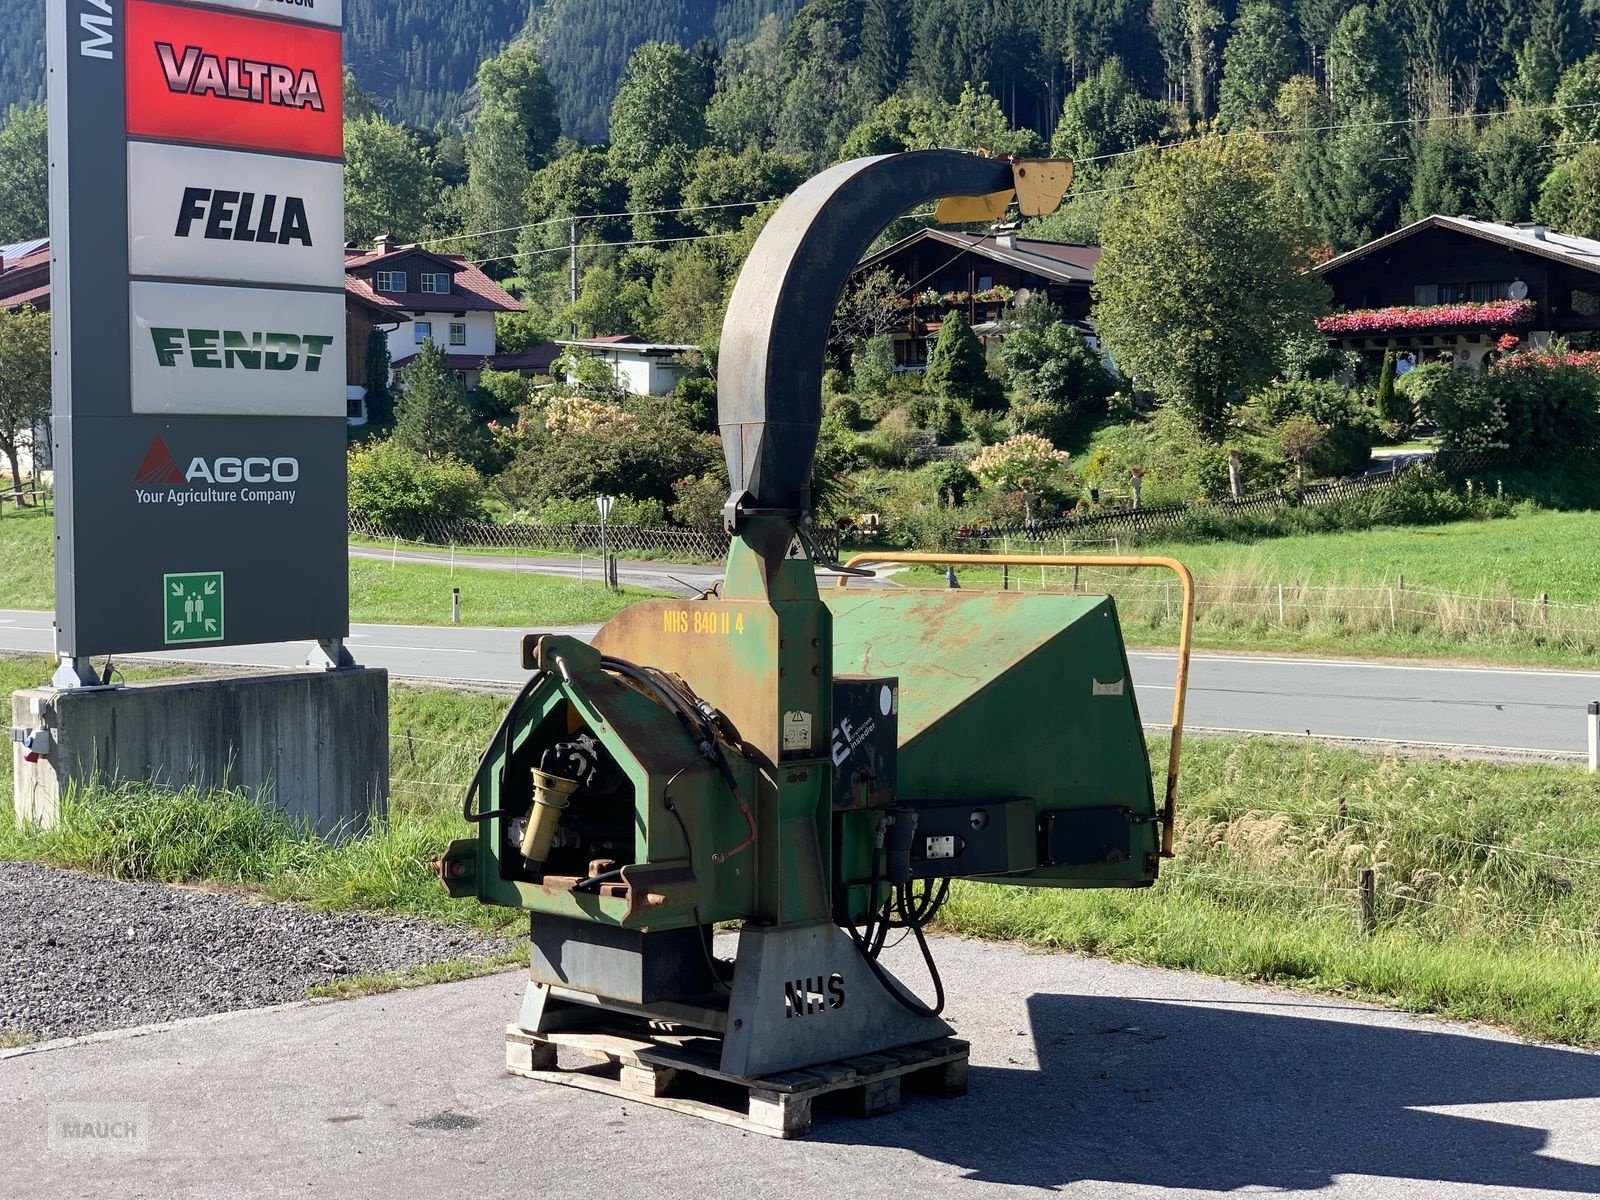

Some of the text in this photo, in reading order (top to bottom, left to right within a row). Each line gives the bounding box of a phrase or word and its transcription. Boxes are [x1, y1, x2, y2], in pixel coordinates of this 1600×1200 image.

[154, 41, 325, 112] VALTRA
[175, 187, 313, 247] FELLA
[150, 327, 333, 372] FENDT
[185, 457, 299, 483] AGCO
[135, 488, 296, 506] Your Agriculture Company
[663, 610, 688, 633] NHS
[694, 611, 717, 634] 840
[735, 612, 744, 635] 4
[785, 972, 845, 1018] NHS
